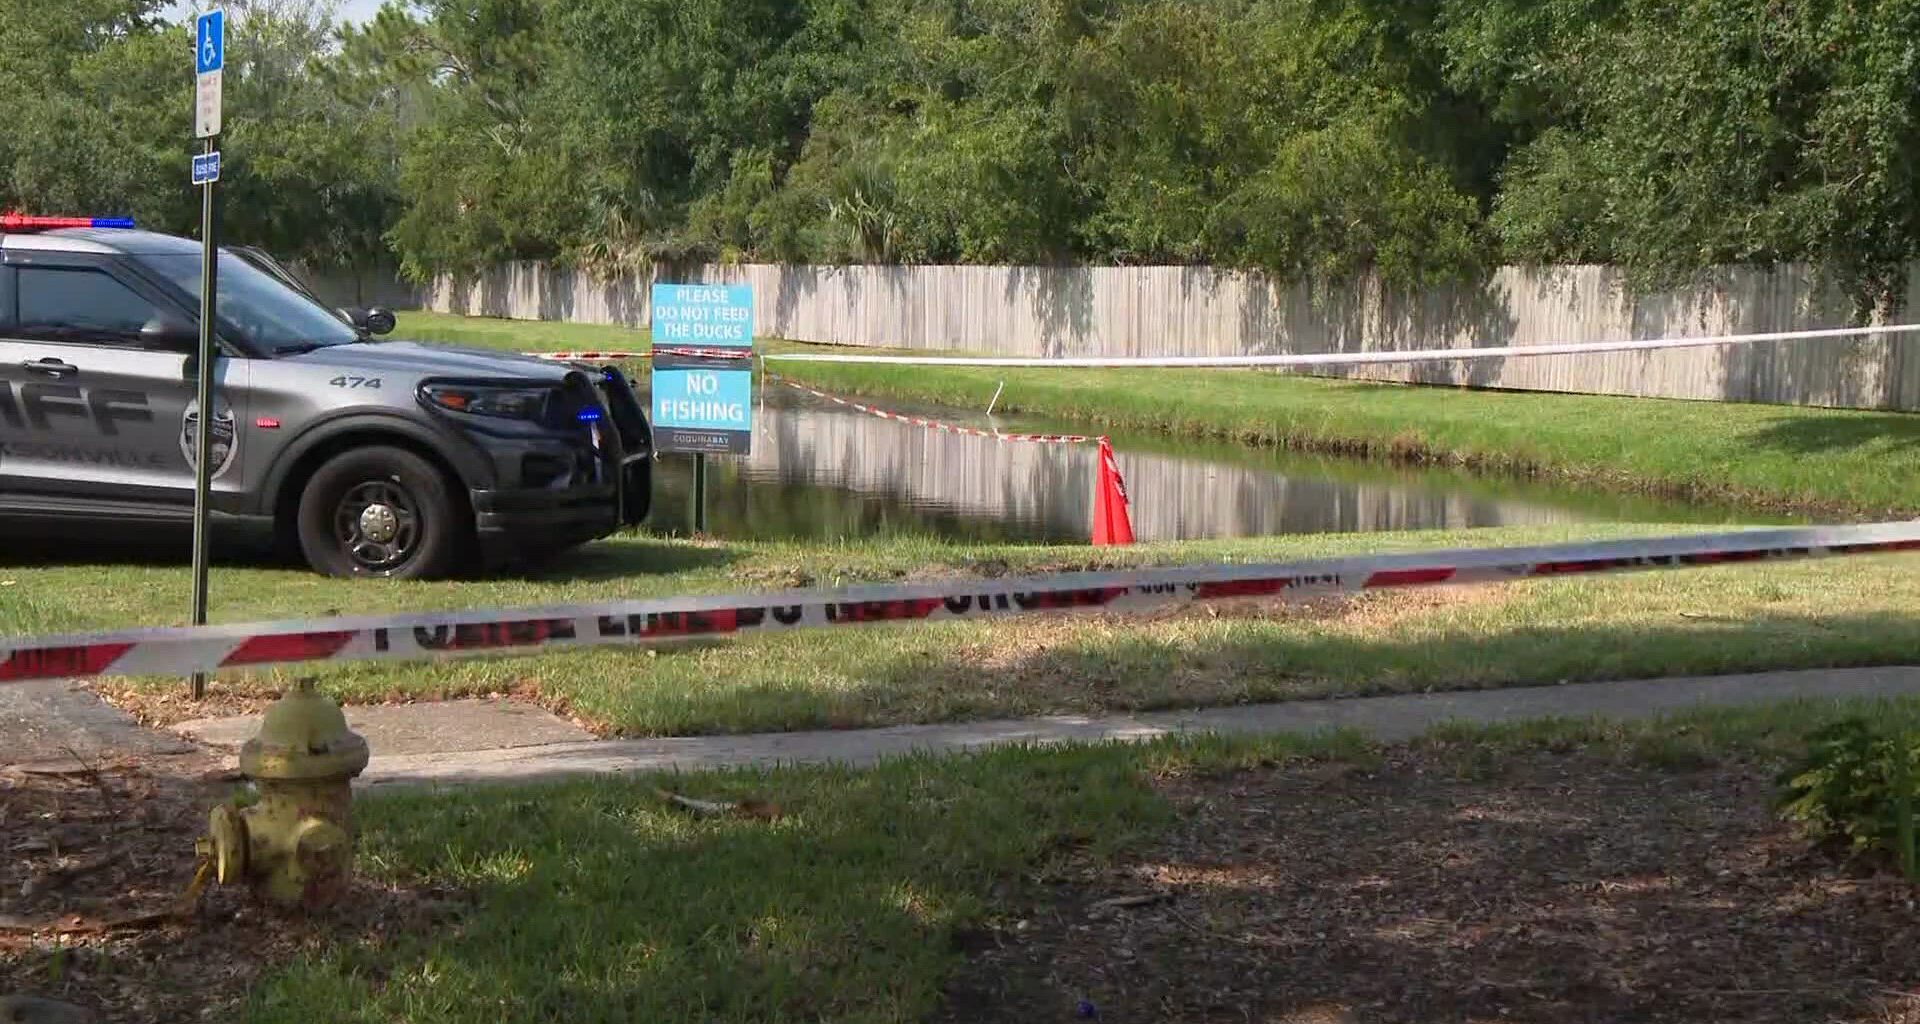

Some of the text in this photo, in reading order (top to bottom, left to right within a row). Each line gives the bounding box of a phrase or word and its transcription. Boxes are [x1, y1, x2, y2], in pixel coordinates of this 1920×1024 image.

[676, 288, 729, 303] PLEASE
[656, 306, 749, 321] DO NOT FEED
[664, 322, 743, 339] THE DUCKS
[329, 376, 382, 389] 474
[687, 374, 718, 395] NO
[661, 400, 744, 422] FISHING
